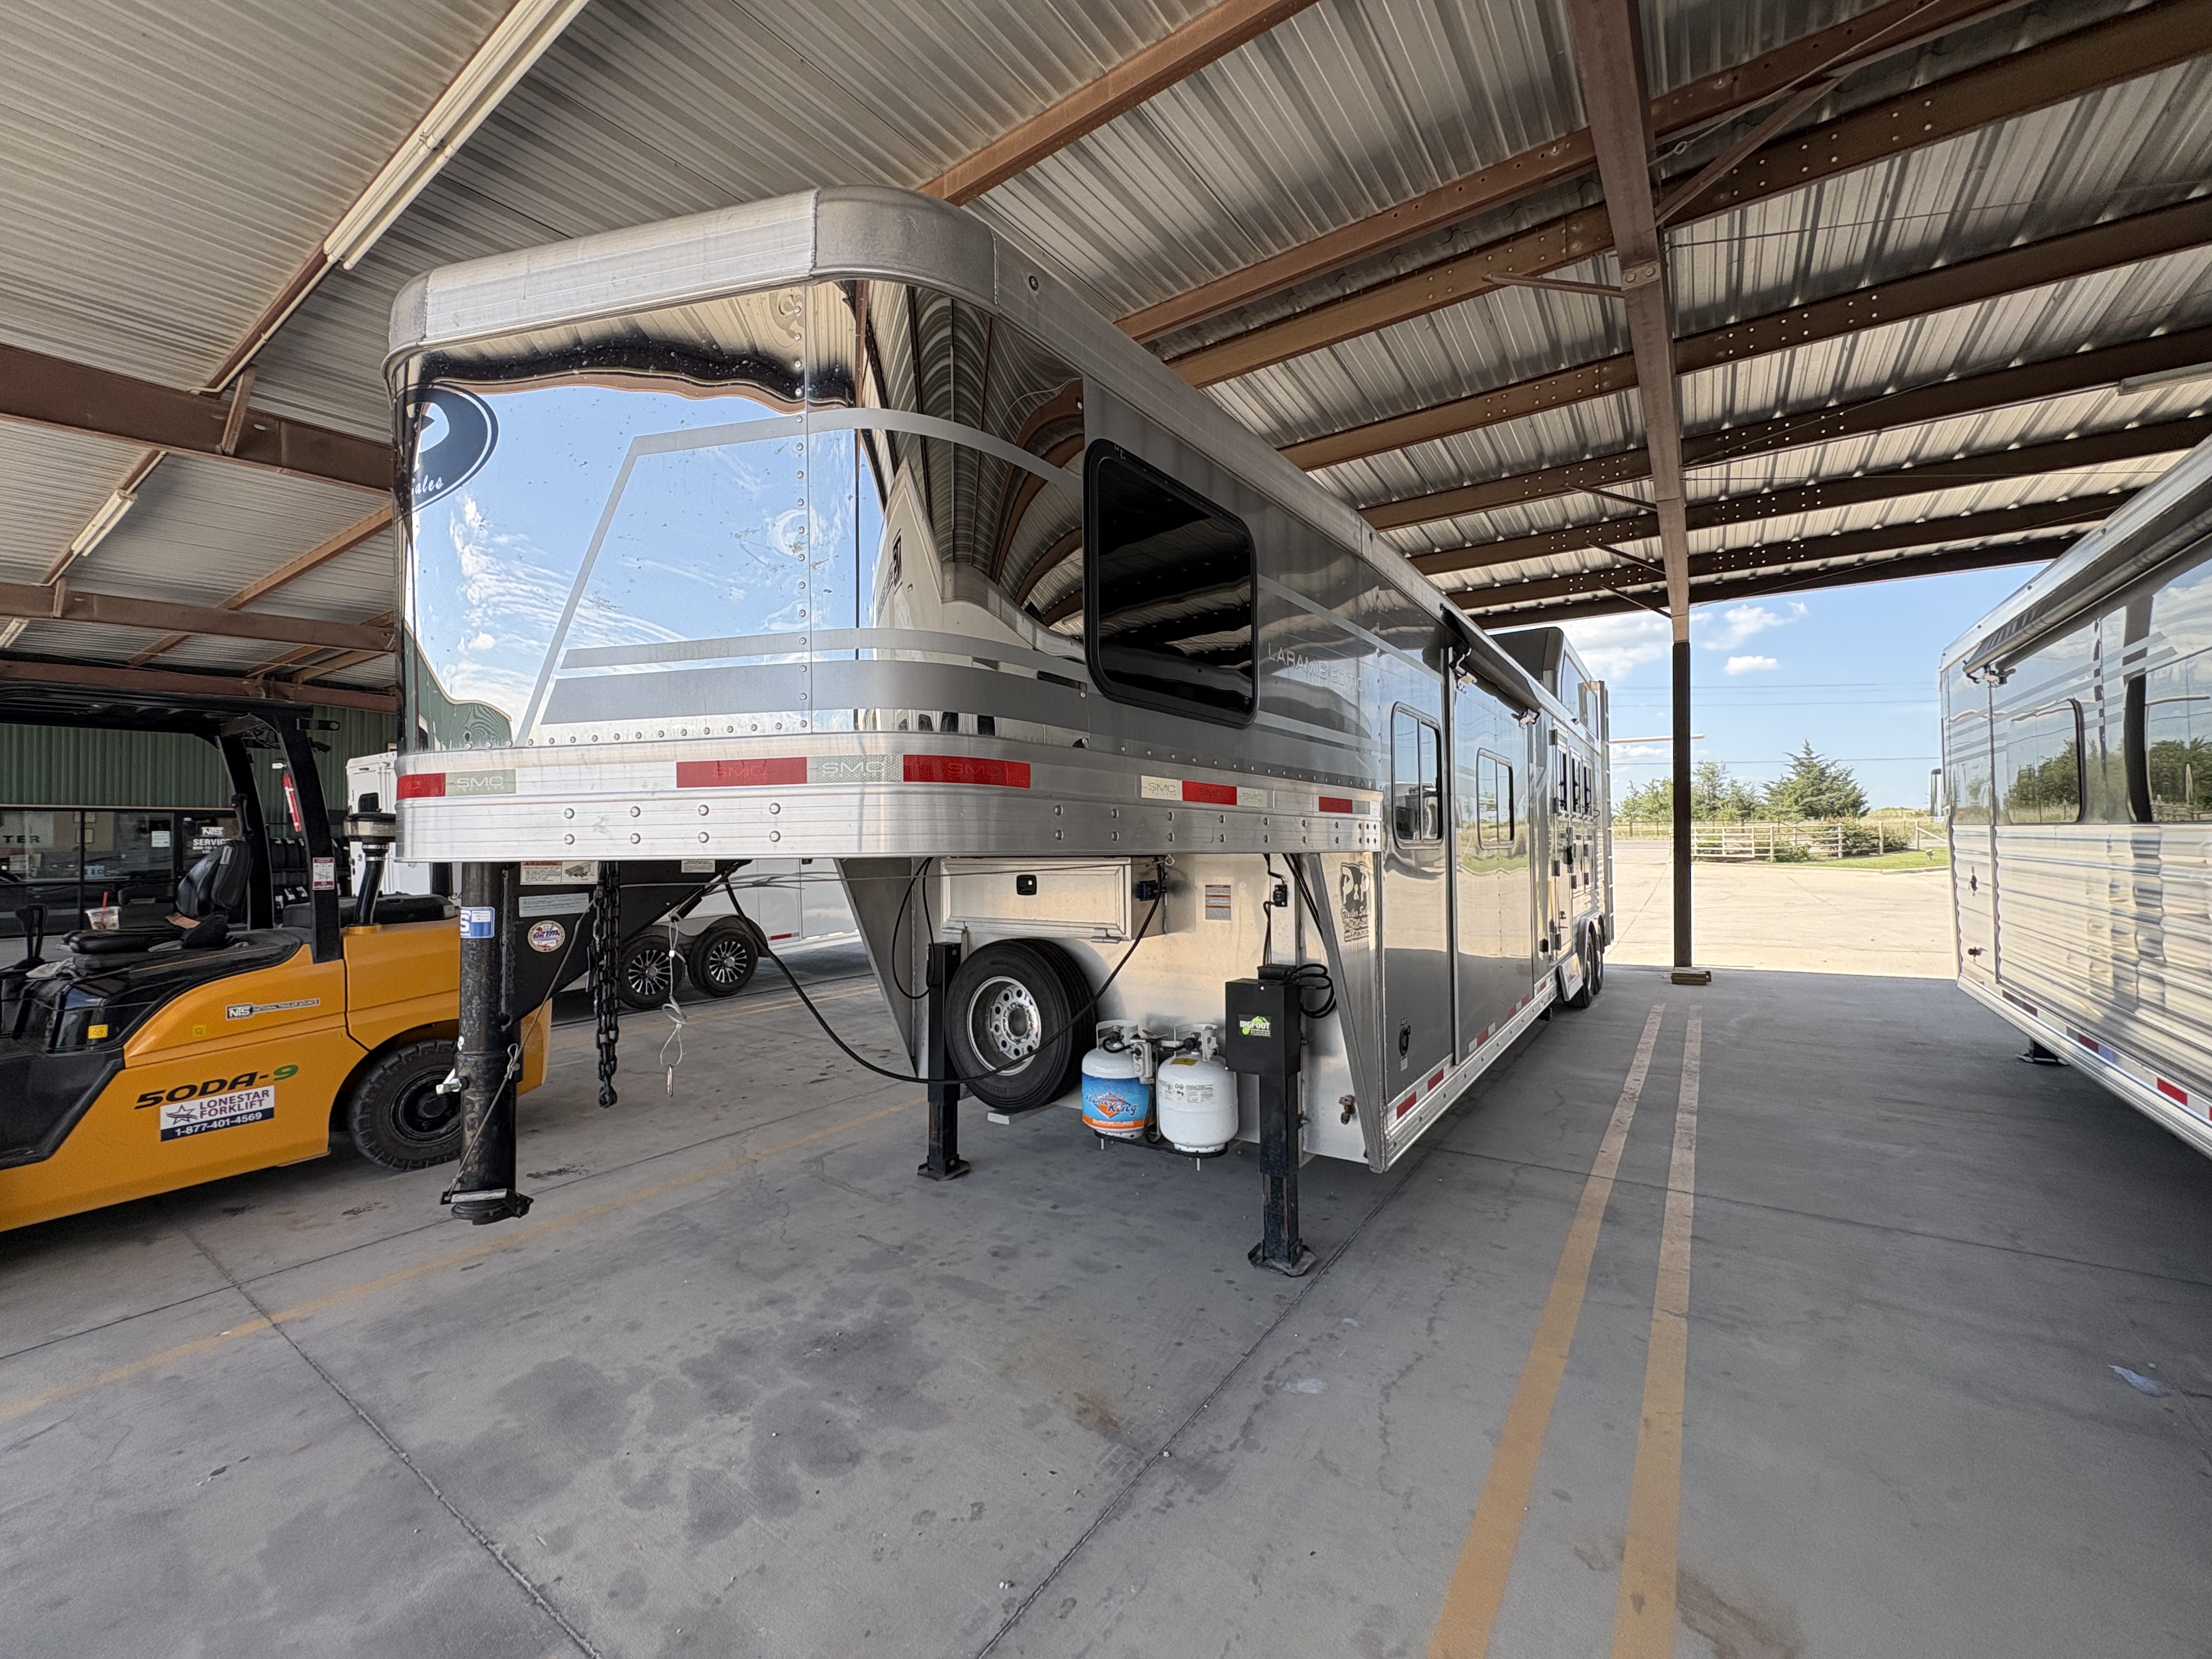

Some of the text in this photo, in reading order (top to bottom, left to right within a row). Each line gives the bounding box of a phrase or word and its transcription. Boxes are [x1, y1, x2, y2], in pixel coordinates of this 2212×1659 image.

[1268, 642, 1327, 680] LARAMIE
[822, 761, 885, 774] SMC
[457, 776, 504, 788] SMC
[1148, 782, 1176, 793] SMC
[1342, 866, 1354, 905] P
[228, 1006, 251, 1017] NTS
[1239, 1020, 1271, 1030] BIGFOOT
[200, 1089, 270, 1110] LONESTAR
[200, 1098, 265, 1119] FORKLIFT
[1108, 1102, 1137, 1116] King
[174, 1111, 263, 1136] 1-877-401-4569
